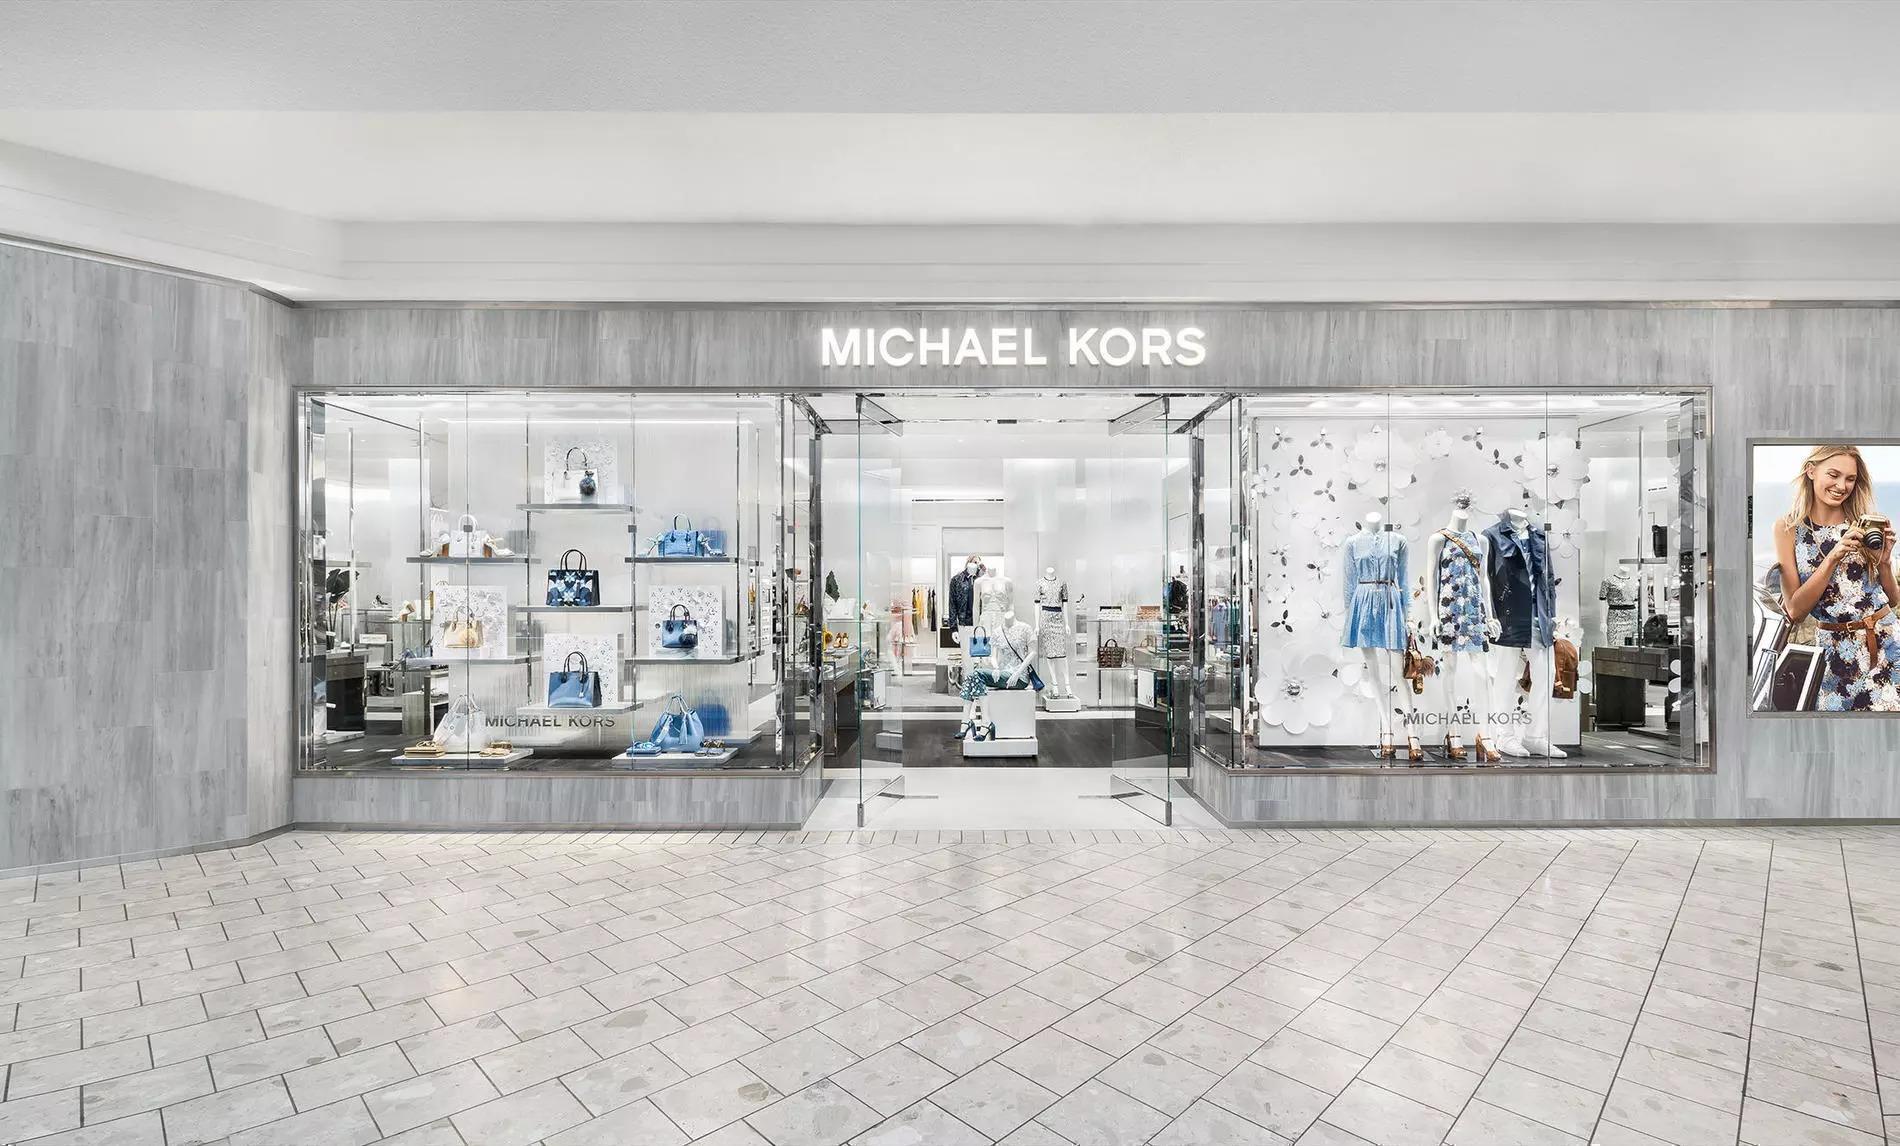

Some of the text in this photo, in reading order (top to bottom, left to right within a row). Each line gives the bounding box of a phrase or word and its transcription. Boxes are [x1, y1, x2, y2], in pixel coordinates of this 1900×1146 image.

[821, 327, 1207, 366] MICHAEL KORS
[485, 715, 615, 727] MICHAEL KORS
[1407, 712, 1533, 725] MICHAEL KORS
